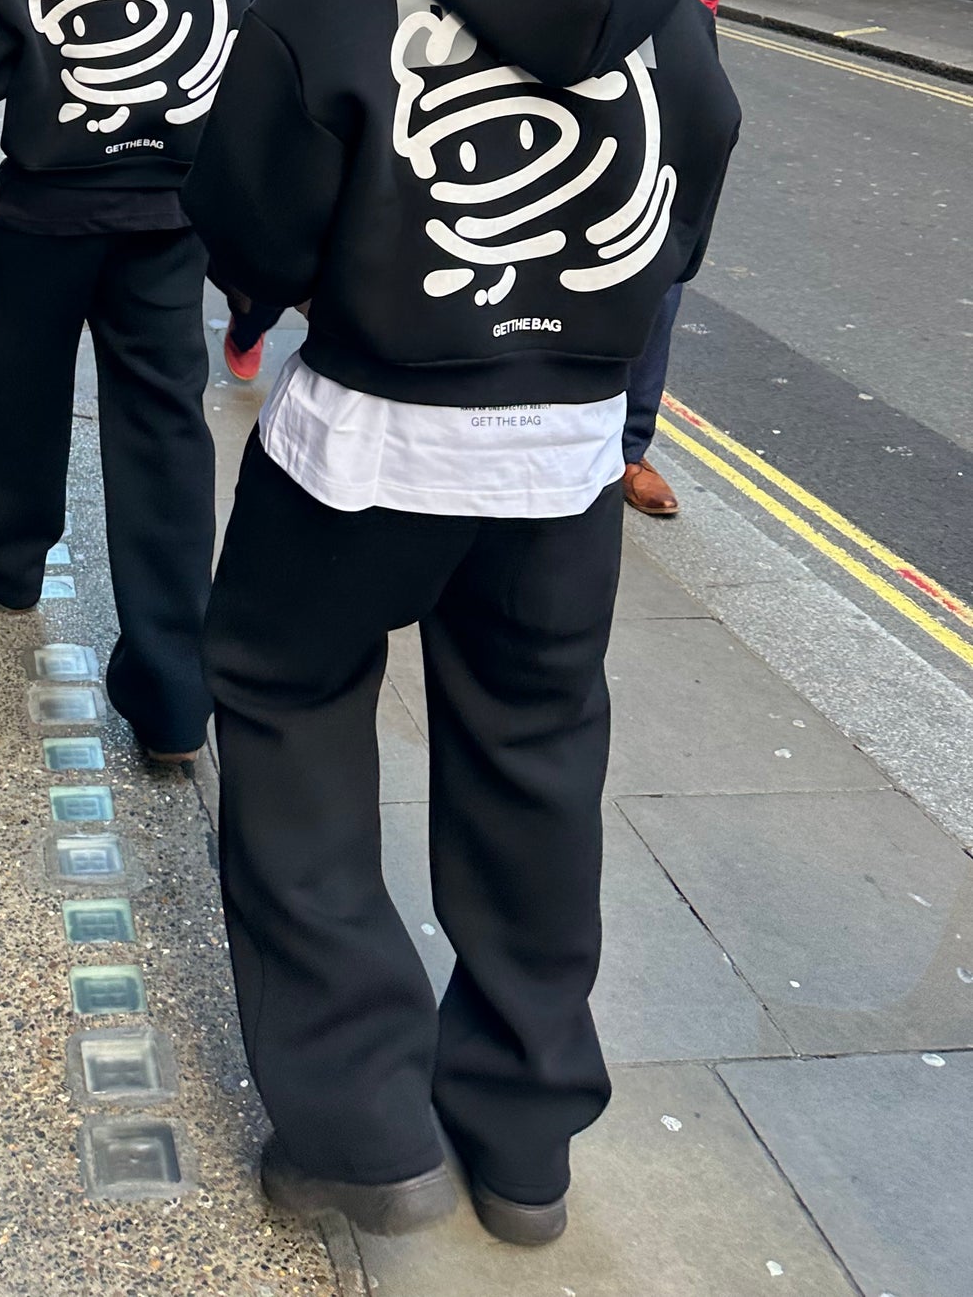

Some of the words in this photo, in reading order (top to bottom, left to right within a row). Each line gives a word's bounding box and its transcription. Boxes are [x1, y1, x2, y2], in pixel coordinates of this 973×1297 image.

[471, 417, 493, 427] GET
[495, 416, 517, 427] THE
[520, 415, 541, 426] BAG
